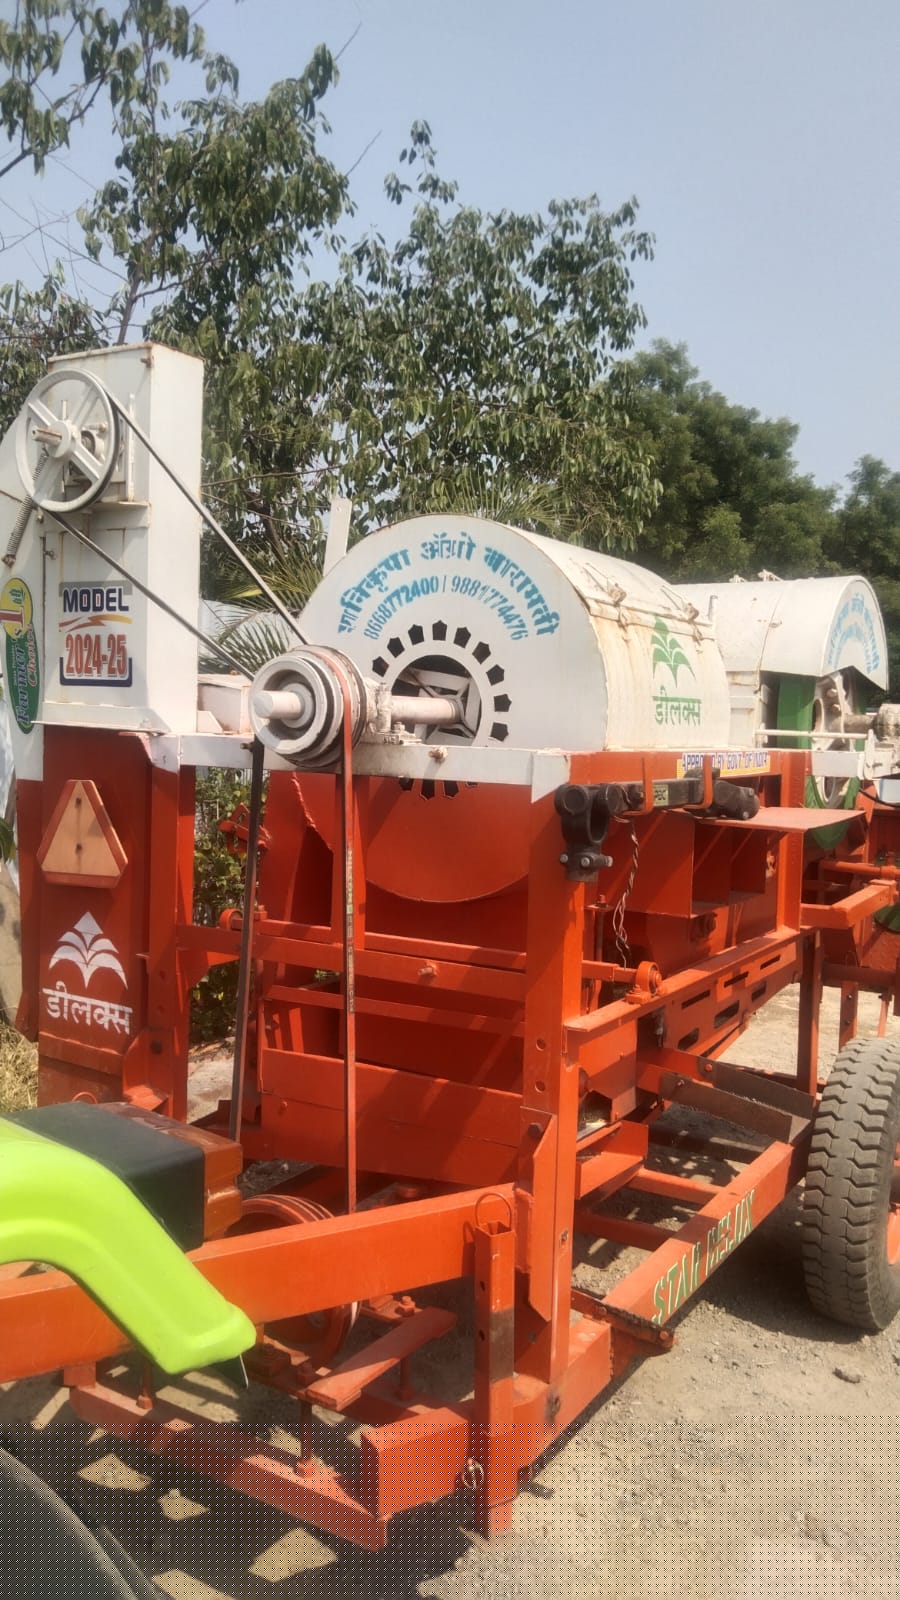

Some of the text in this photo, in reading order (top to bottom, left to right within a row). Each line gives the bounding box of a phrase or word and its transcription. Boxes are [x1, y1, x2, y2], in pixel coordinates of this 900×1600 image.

[63, 588, 129, 613] MODEL
[364, 576, 439, 640] 8668772400
[451, 575, 529, 641] 9881774476
[65, 633, 127, 676] 2024-25
[652, 685, 702, 726] डीलक्स
[42, 981, 133, 1035] डीलक्स
